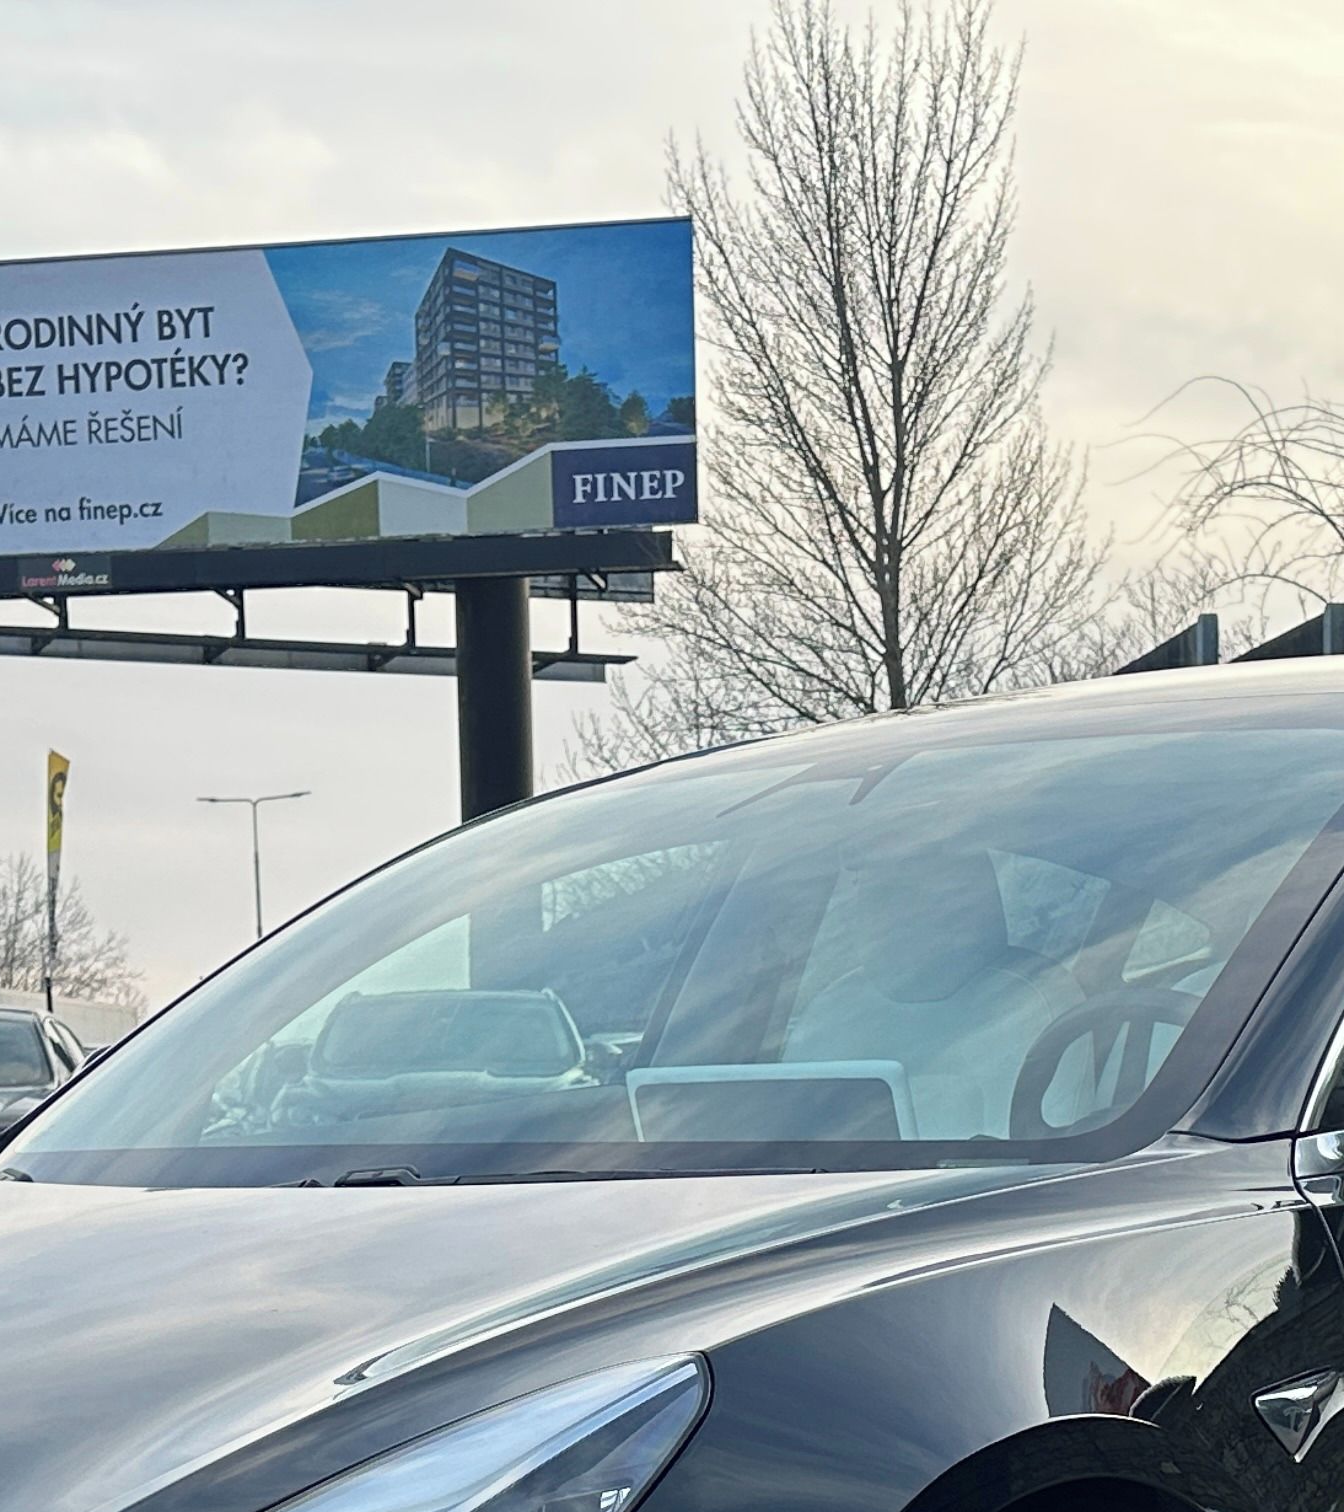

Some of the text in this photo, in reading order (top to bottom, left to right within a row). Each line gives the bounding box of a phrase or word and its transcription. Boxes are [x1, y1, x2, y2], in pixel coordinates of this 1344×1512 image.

[156, 306, 215, 342] BYT
[57, 347, 249, 395] HYPOTÉKY?
[87, 406, 184, 444] ŘEŠENÍ
[572, 470, 685, 503] FINEP
[45, 506, 72, 523] na
[78, 496, 164, 525] finep.cz
